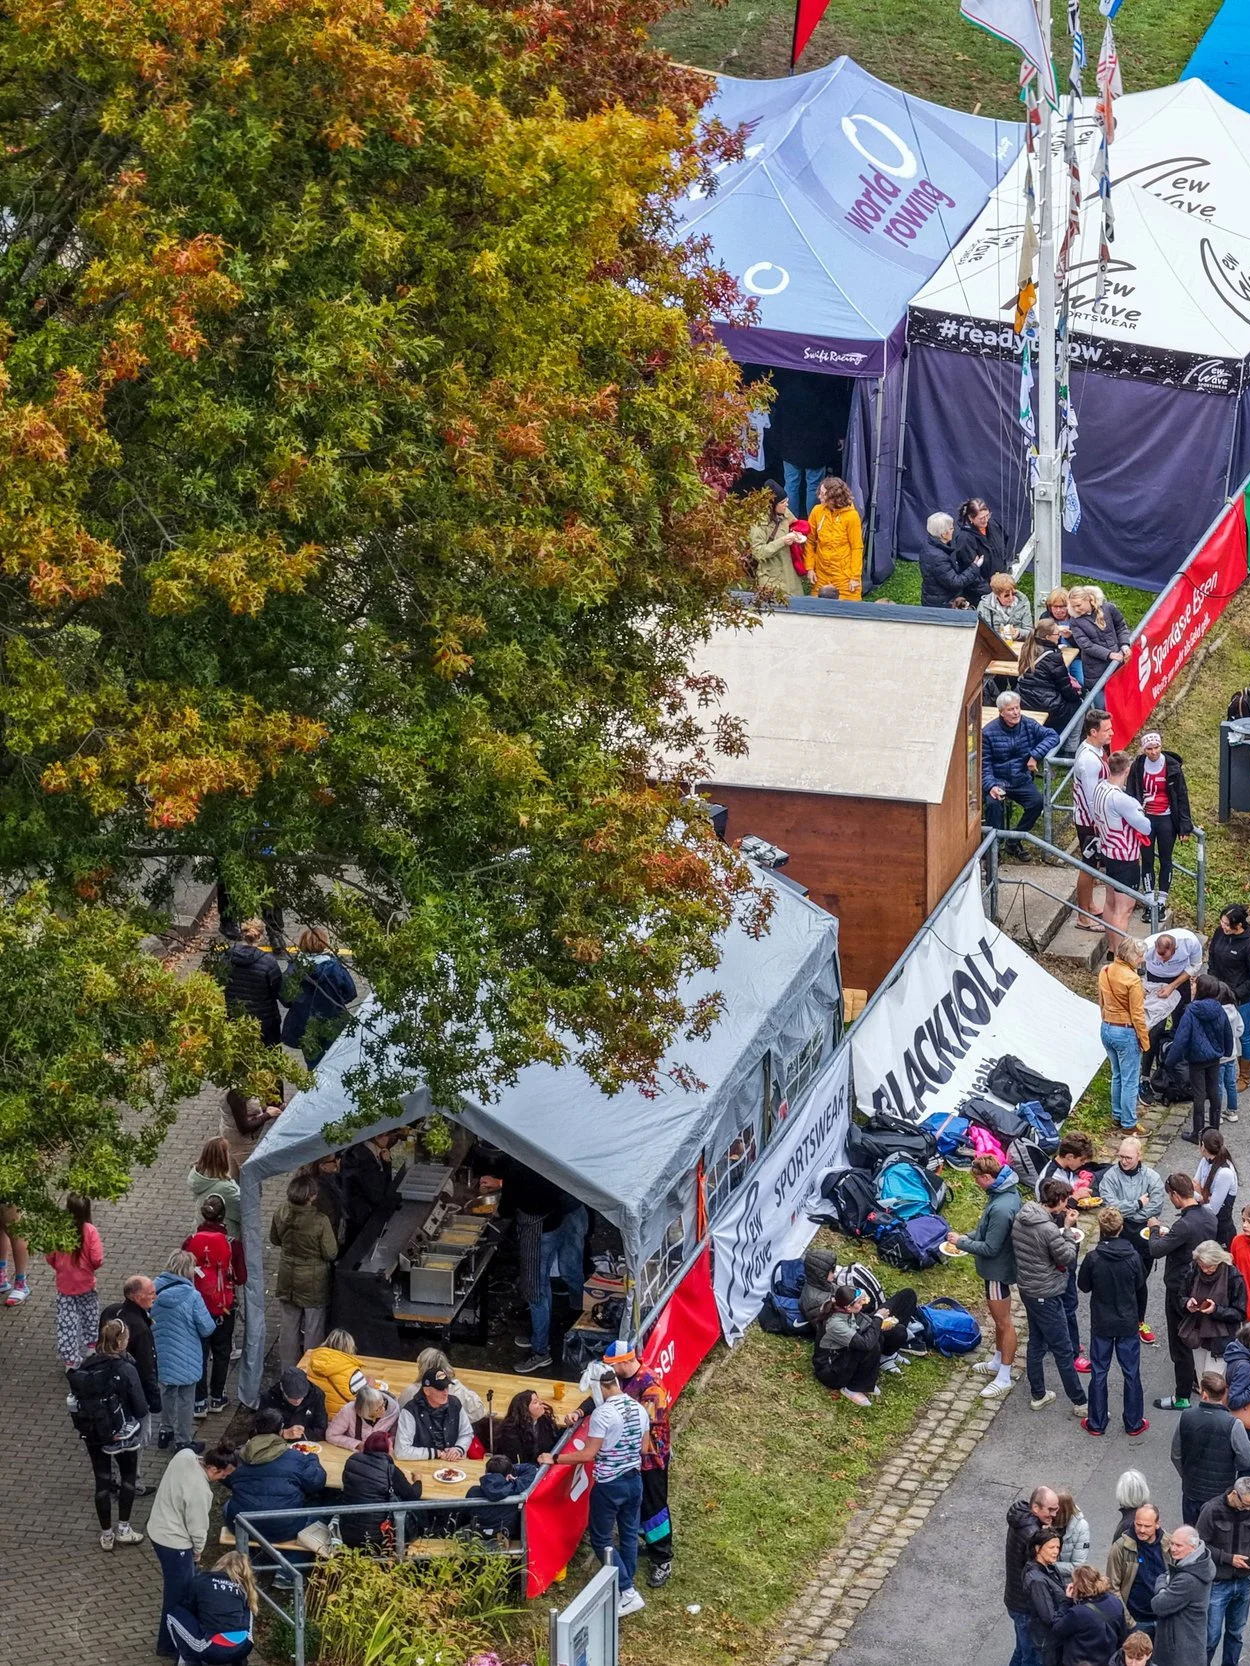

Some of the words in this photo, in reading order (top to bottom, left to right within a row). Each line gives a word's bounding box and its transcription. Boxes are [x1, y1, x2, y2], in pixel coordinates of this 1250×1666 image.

[844, 163, 902, 234] world
[883, 179, 956, 248] rowing
[1055, 309, 1138, 330] PORTSWEAR
[803, 347, 829, 363] Swift
[774, 1085, 845, 1208] SPORTSWEAR
